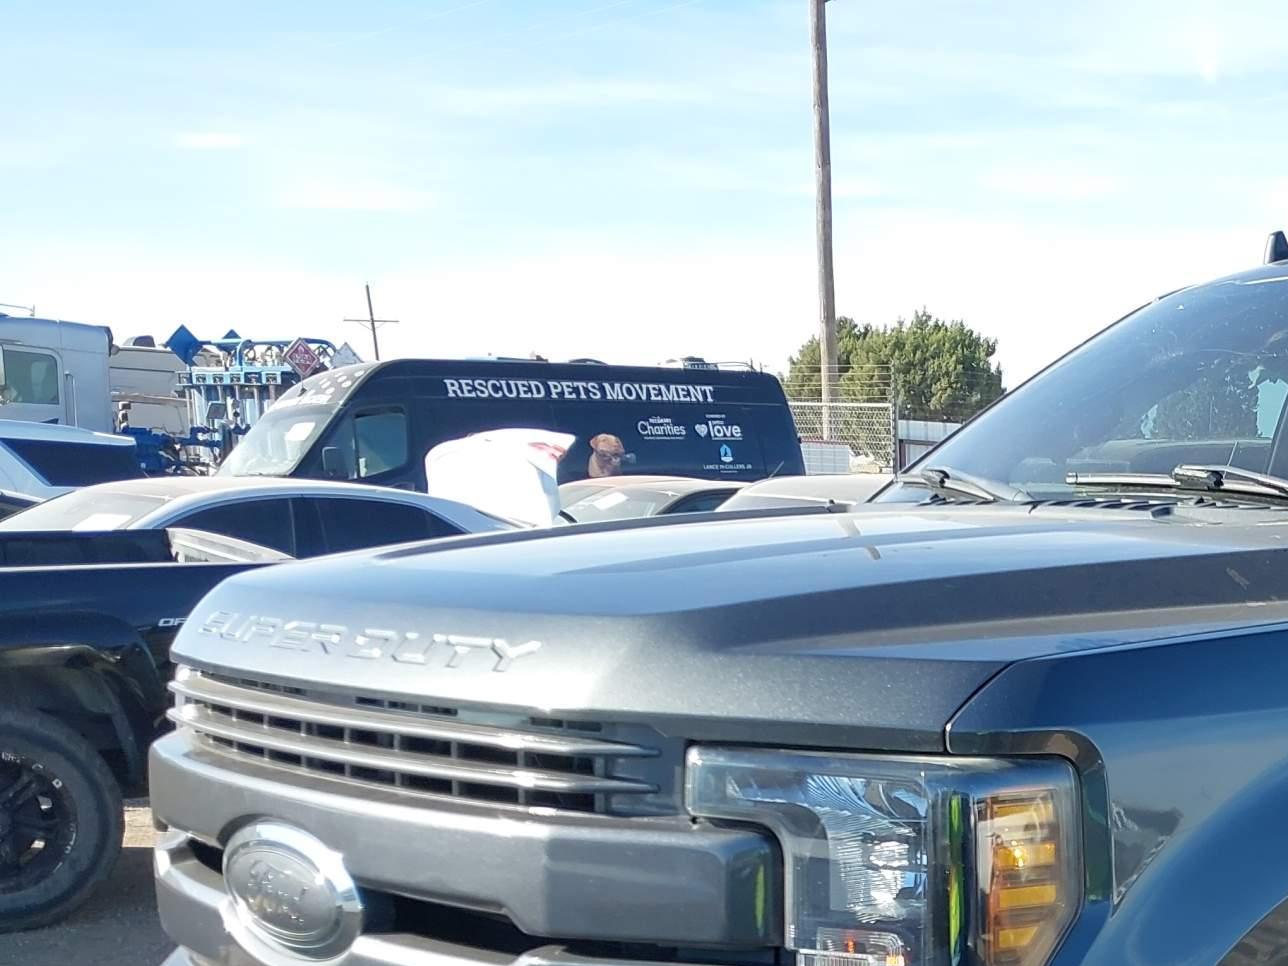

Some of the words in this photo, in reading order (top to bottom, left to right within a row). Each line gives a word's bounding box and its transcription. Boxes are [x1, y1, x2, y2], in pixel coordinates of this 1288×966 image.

[444, 379, 545, 398] RESCUED
[550, 381, 601, 400] PETS
[603, 382, 714, 403] MOVEMENT
[638, 421, 686, 436] Charities
[708, 420, 742, 437] love
[199, 610, 347, 655] SUPER
[347, 628, 542, 673] DUTY
